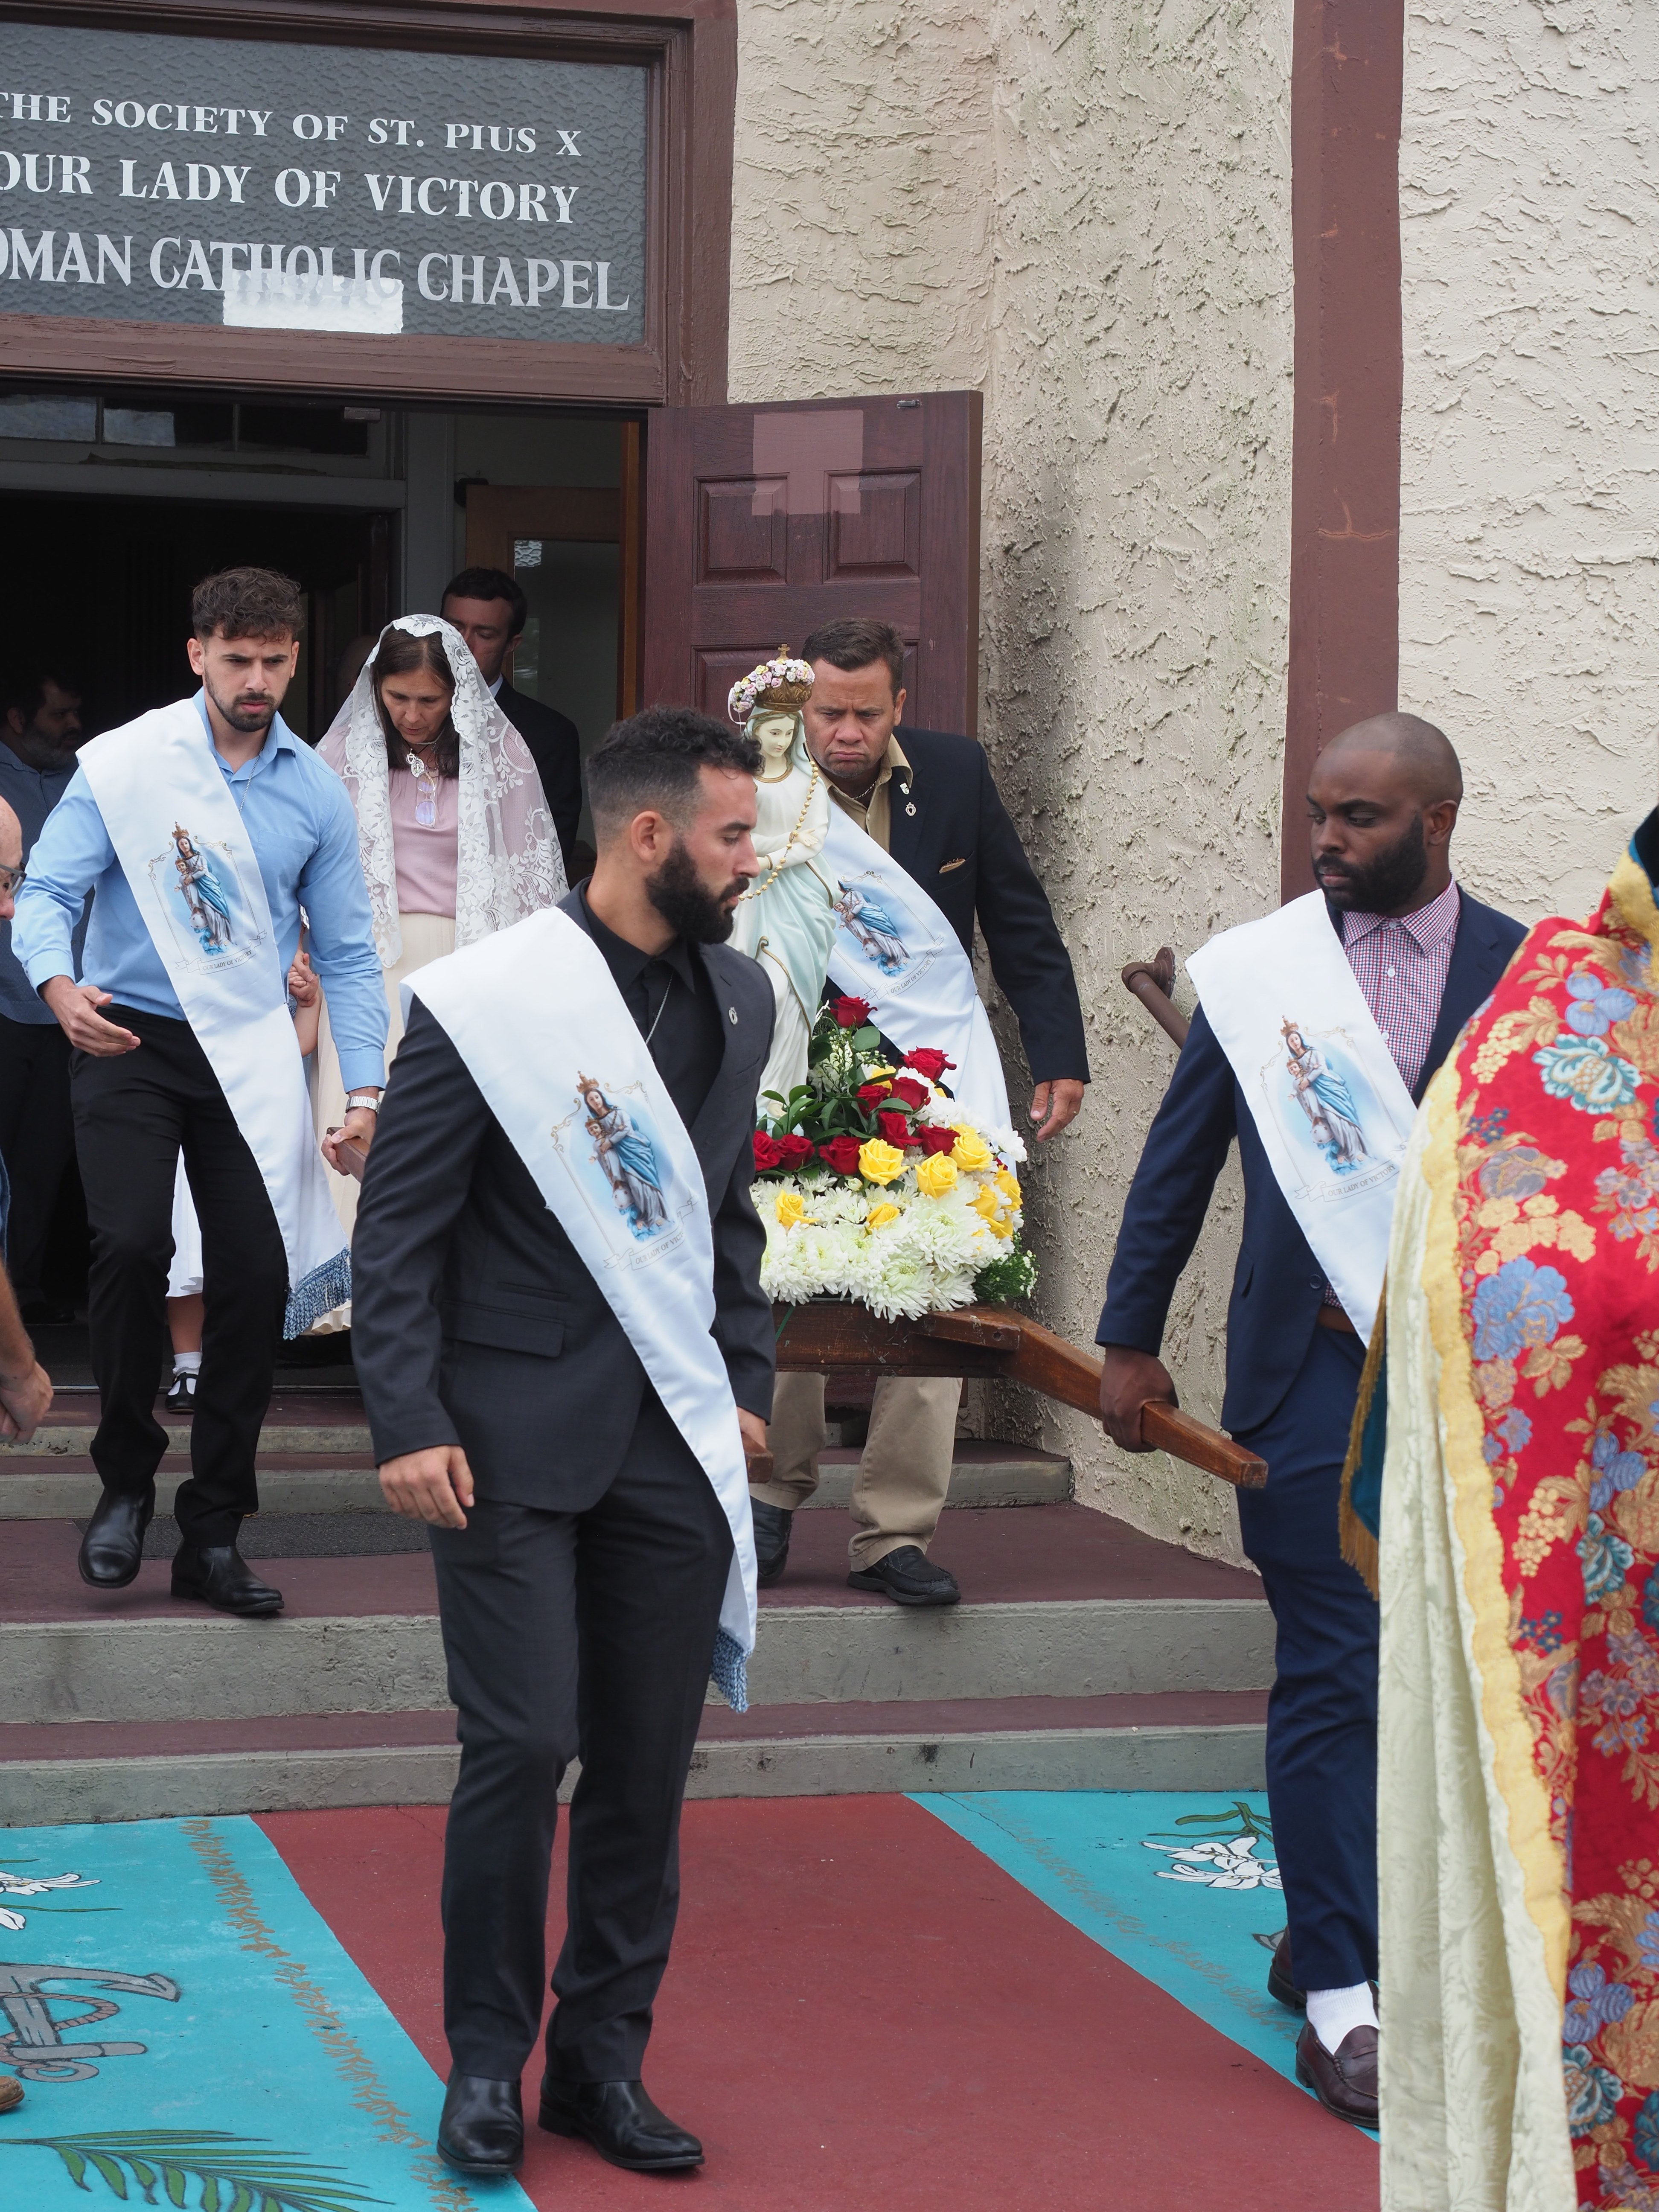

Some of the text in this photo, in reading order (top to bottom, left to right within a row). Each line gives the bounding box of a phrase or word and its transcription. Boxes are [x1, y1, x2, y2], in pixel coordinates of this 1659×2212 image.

[92, 99, 273, 136] SOCIETY
[293, 114, 348, 141] OF
[368, 118, 424, 147] ST.
[445, 123, 536, 153] PIUS
[556, 130, 582, 156] X
[119, 159, 251, 204] LADY
[275, 168, 341, 208] OF
[364, 173, 579, 224] VICTORY
[0, 228, 629, 310] MAN CATHOLIC CHAPEL
[234, 950, 252, 963] VICTORY
[891, 985, 901, 993] OUR
[900, 978, 911, 989] LADY
[916, 958, 931, 976] VICTORY
[1328, 1188, 1343, 1196] OUR
[1344, 1182, 1359, 1193] LADY
[1369, 1164, 1396, 1182] VICTORY
[635, 1255, 649, 1264] OUR
[647, 1246, 660, 1259] LADY
[661, 1242, 669, 1251] OF
